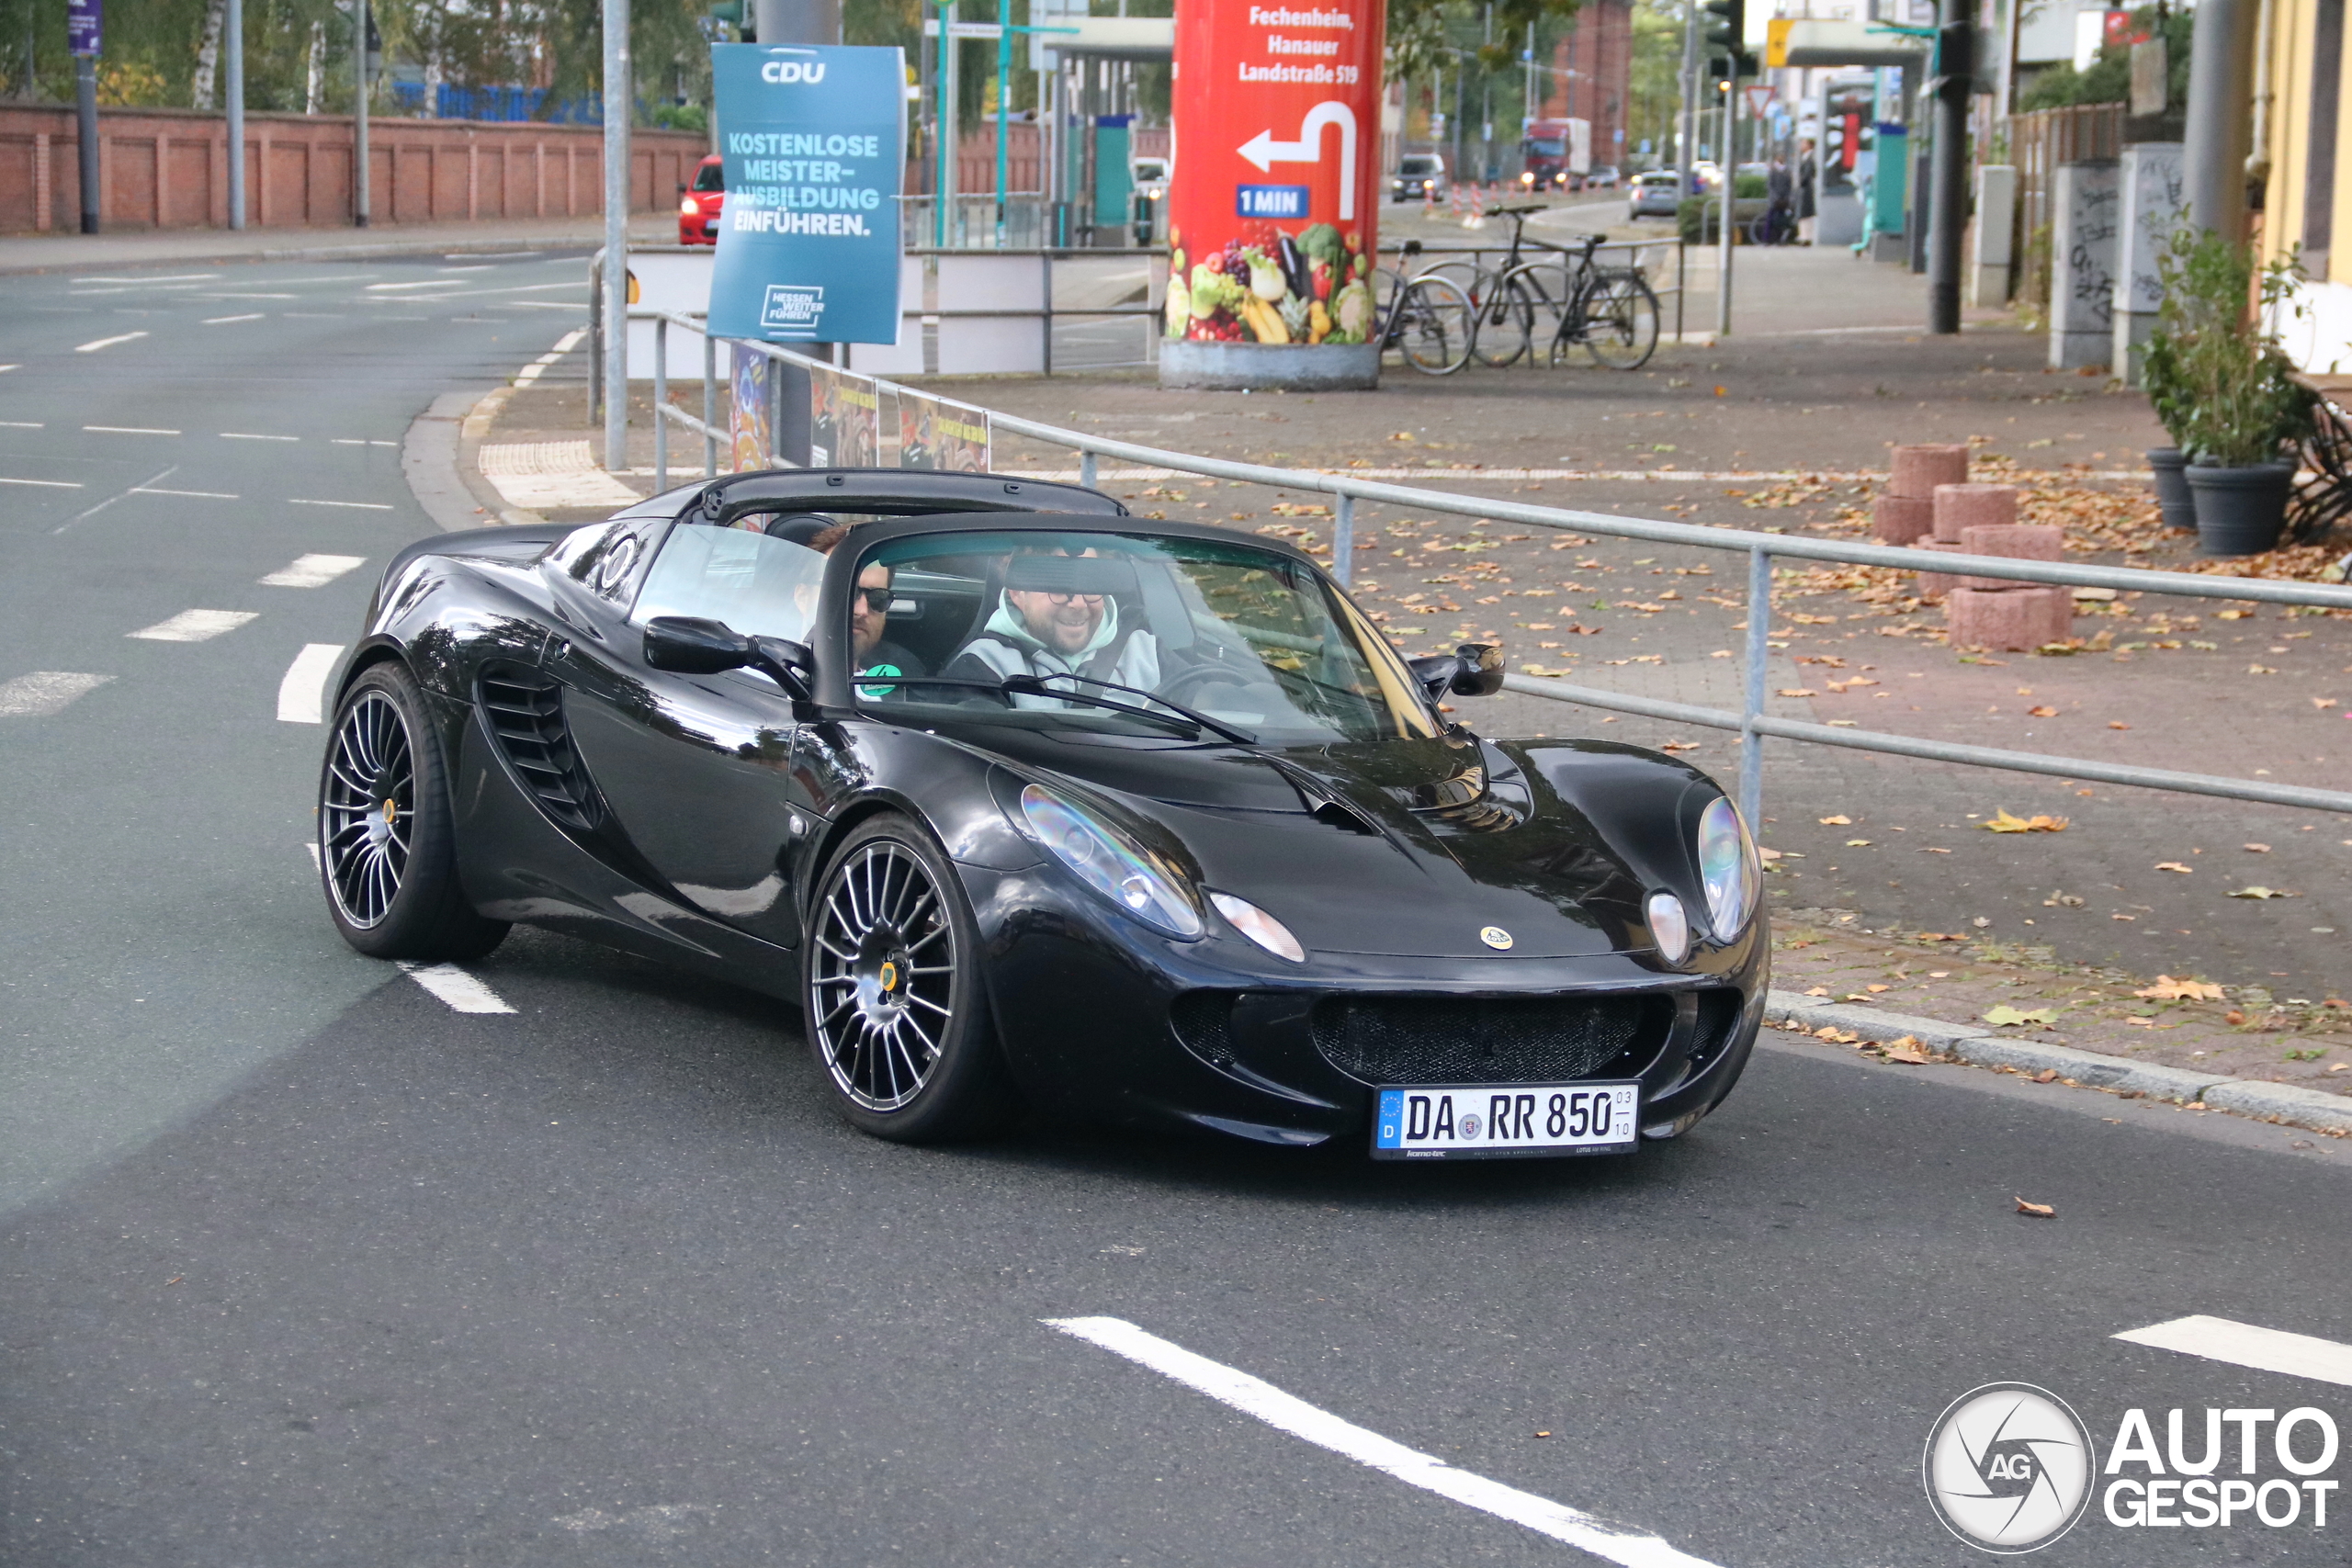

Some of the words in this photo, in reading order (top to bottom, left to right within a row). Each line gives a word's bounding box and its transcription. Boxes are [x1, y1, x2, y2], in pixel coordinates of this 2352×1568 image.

[1250, 6, 1354, 30] Fechenheim,
[1267, 34, 1340, 56] Hanauer
[762, 61, 826, 84] CDU
[1238, 61, 1334, 83] Landstraße
[1336, 64, 1359, 84] 519
[729, 132, 878, 157] KOSTENLOSE
[744, 159, 855, 183] MEISTER-
[732, 185, 880, 209] AUSBILDUNG
[1240, 189, 1250, 212] 1
[1254, 190, 1298, 213] MIN
[734, 206, 871, 236] EINFÜHREN.
[772, 292, 814, 303] HESSEN
[782, 301, 825, 312] WEITER
[769, 308, 810, 320] FÜHREN
[1616, 1090, 1632, 1103] 03
[1407, 1095, 1454, 1140] DA
[1488, 1094, 1535, 1139] RR
[1546, 1092, 1611, 1138] 850
[1384, 1124, 1395, 1139] D
[1615, 1122, 1629, 1135] 10
